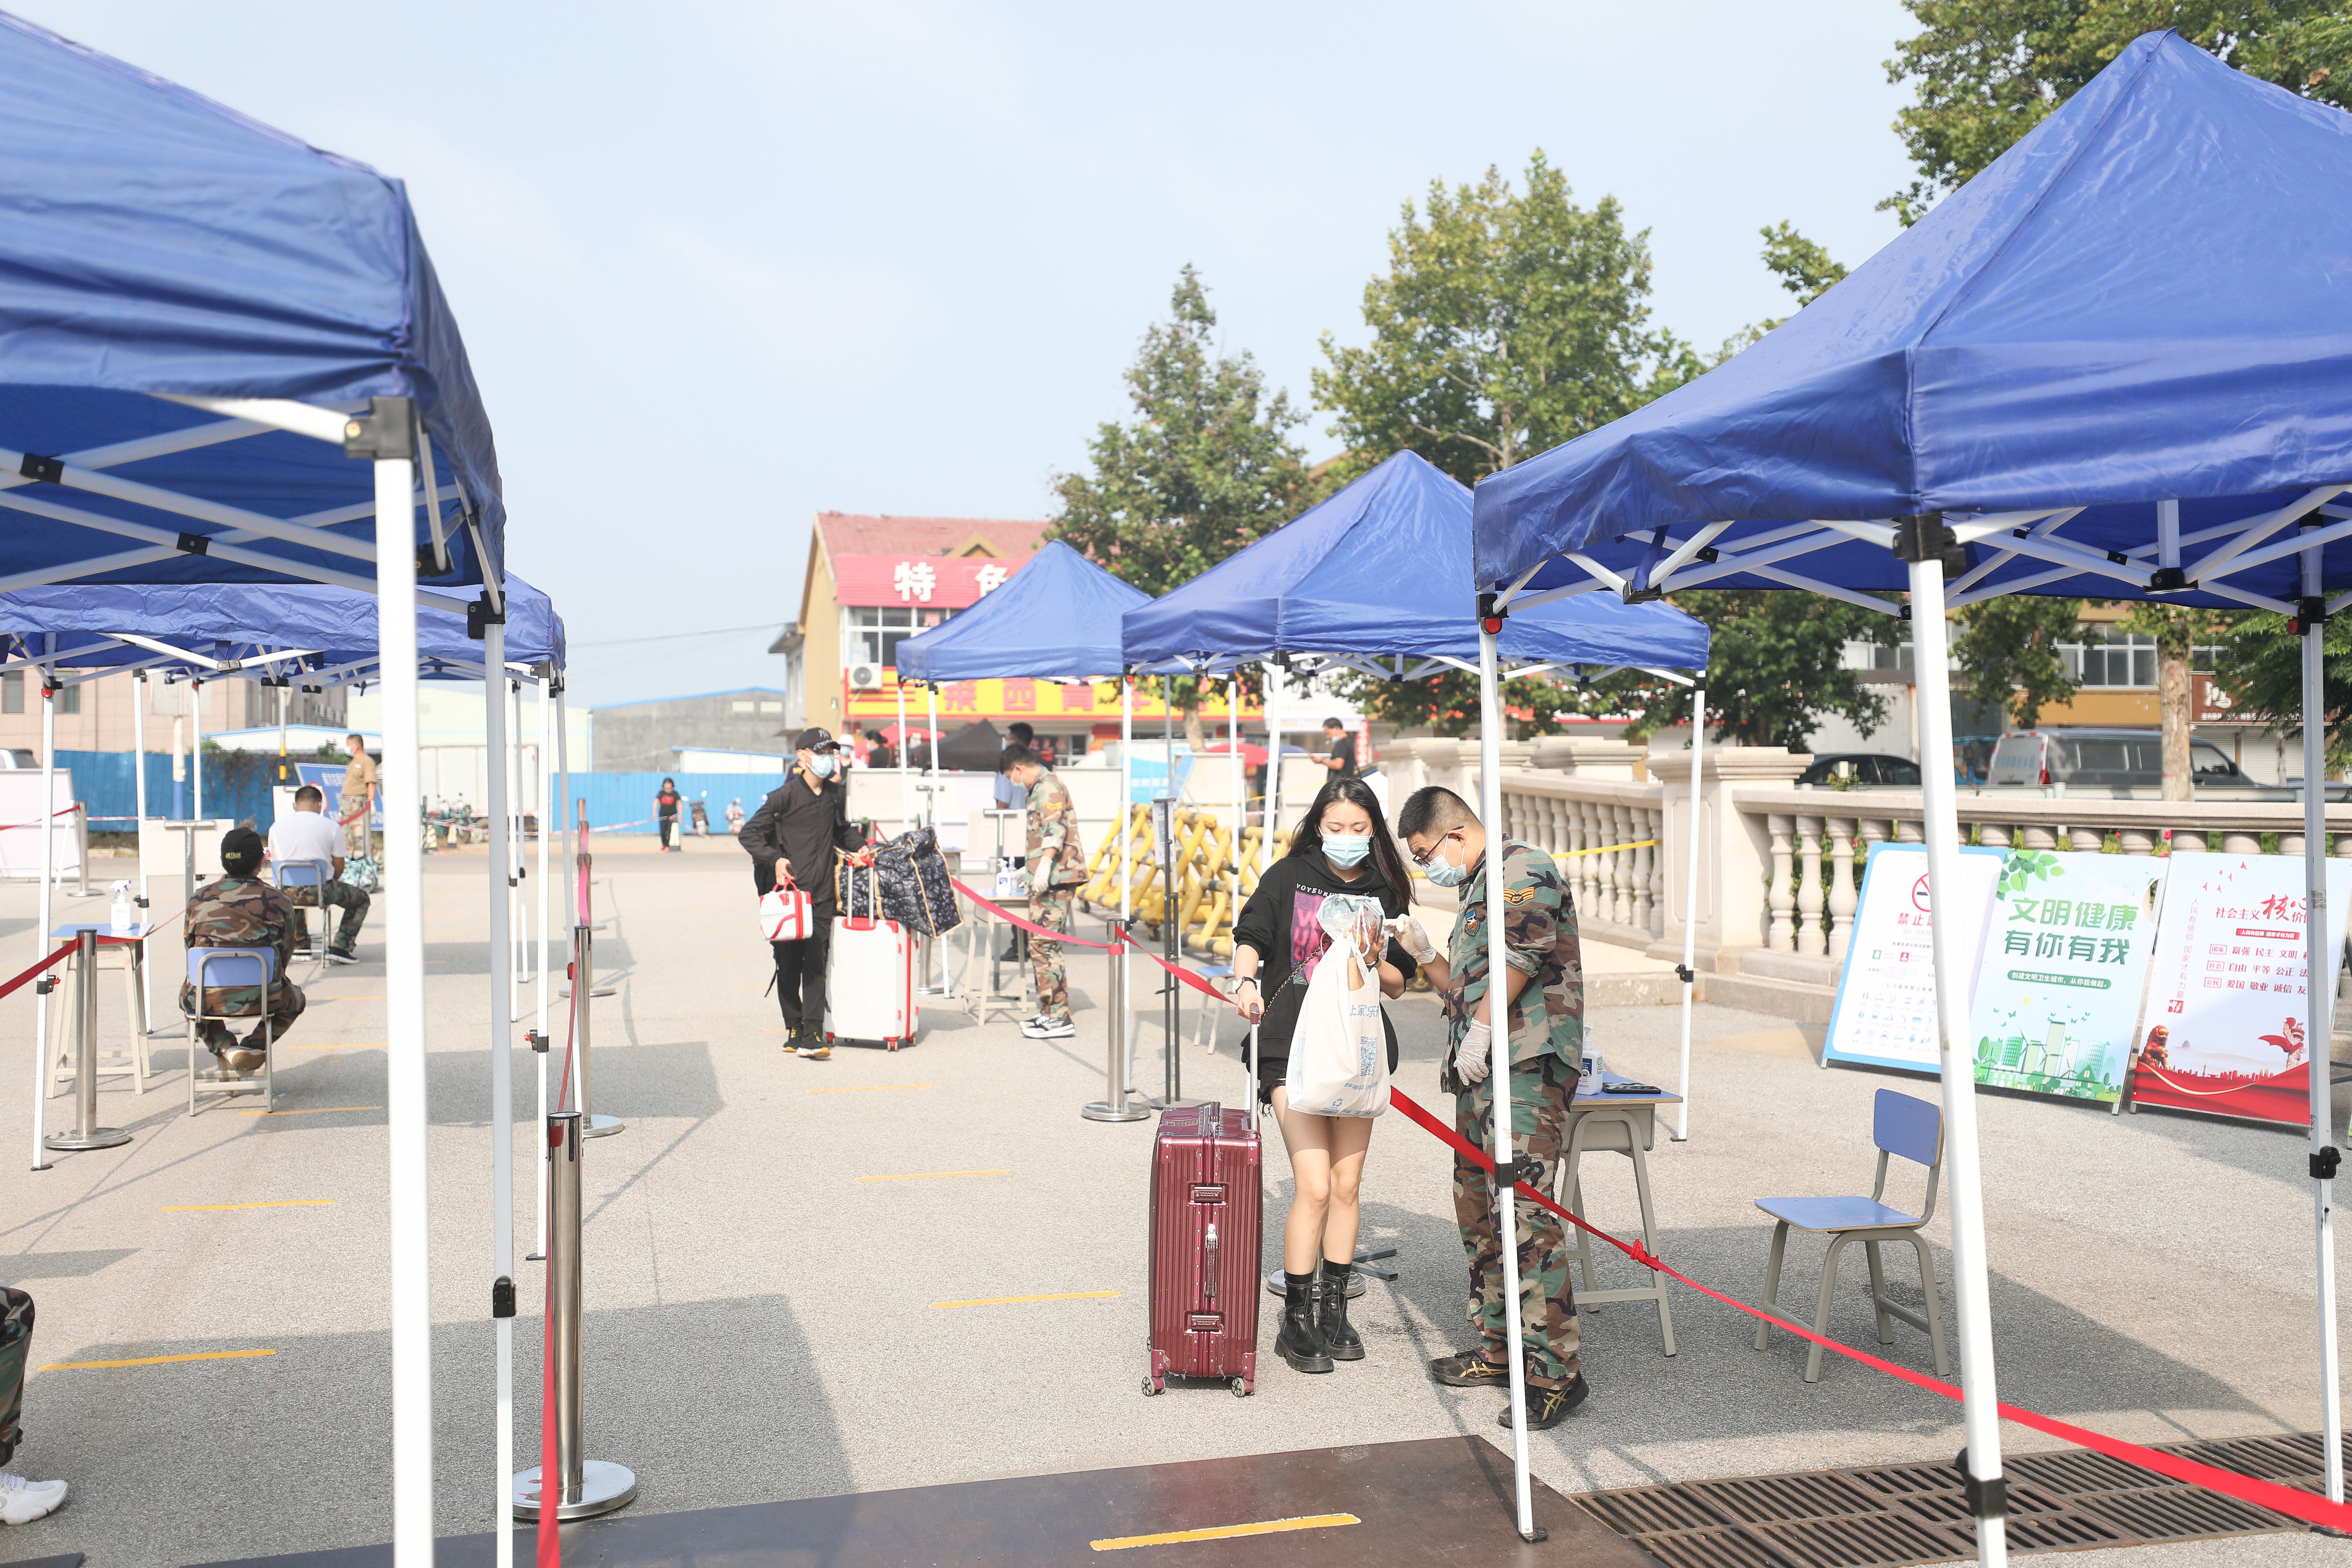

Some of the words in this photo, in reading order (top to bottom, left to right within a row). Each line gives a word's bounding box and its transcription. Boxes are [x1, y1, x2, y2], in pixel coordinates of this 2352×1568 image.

[2008, 898, 2139, 931] 文明健康
[2185, 897, 2199, 941] 人民有信仰
[2215, 907, 2260, 920] 社会主义
[2004, 930, 2130, 965] 有你有我
[2233, 946, 2250, 955] 富强
[2256, 947, 2274, 958] 民主
[2278, 949, 2297, 959] 文明
[2176, 945, 2192, 998] 国家才有力量
[2229, 963, 2247, 972] 自由
[2252, 965, 2271, 974] 平等
[2276, 967, 2295, 977] 公正
[2226, 979, 2245, 989] 爱国
[2250, 981, 2269, 992] 敬业
[2273, 983, 2293, 994] 诚信
